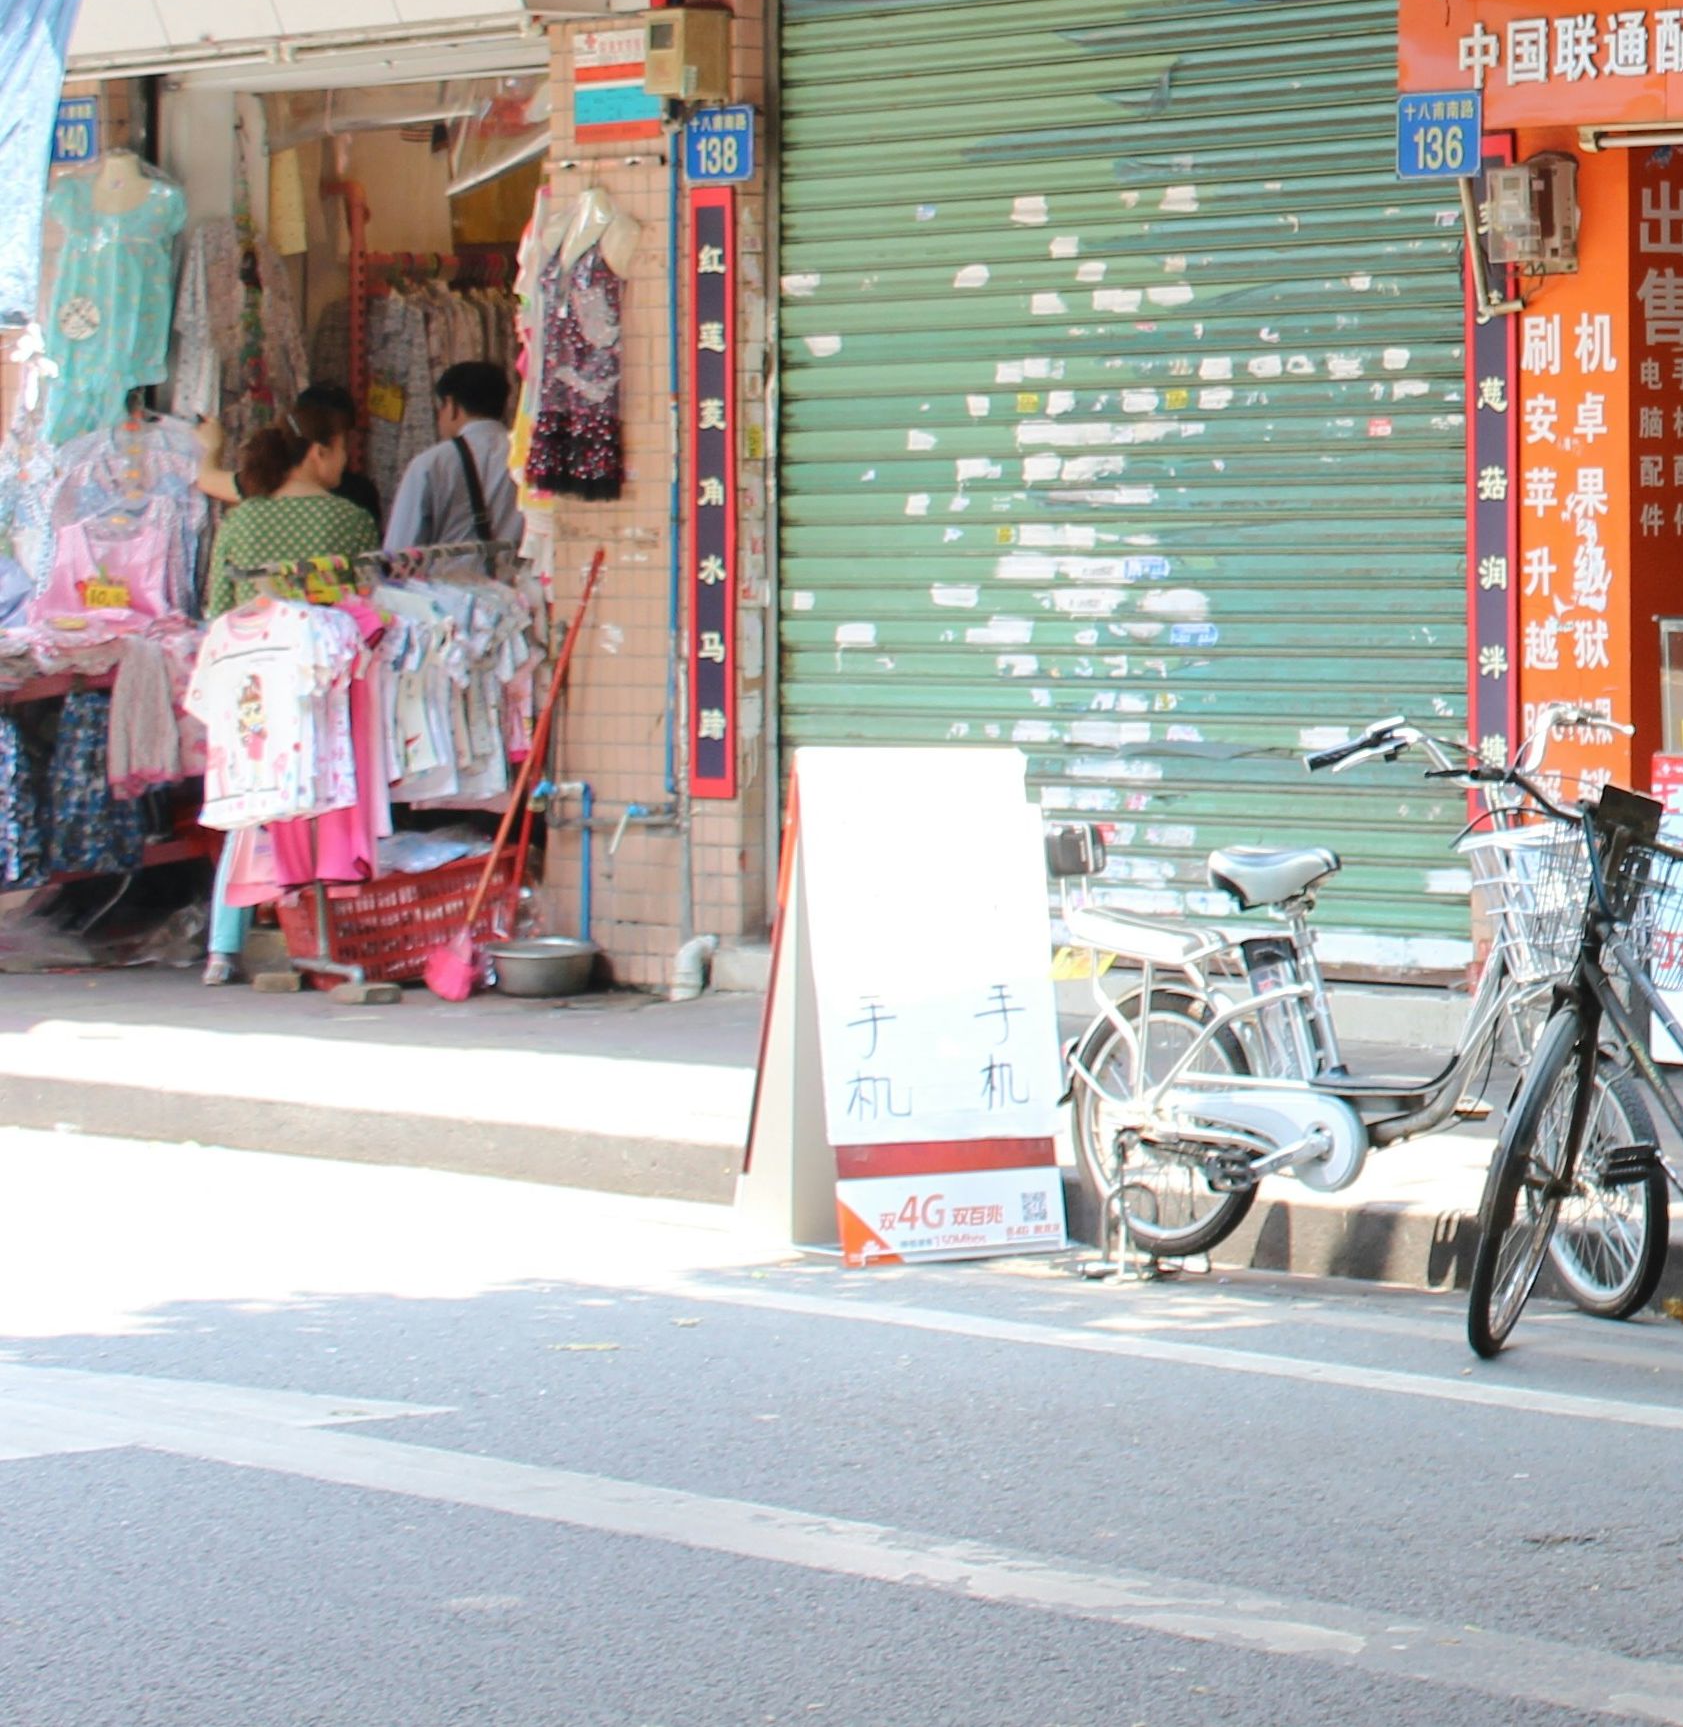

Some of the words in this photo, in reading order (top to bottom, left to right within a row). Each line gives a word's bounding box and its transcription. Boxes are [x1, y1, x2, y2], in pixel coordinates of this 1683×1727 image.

[1404, 99, 1475, 122] 十八甫南路
[56, 124, 89, 158] 140
[696, 135, 738, 175] 138
[1413, 126, 1464, 170] 136
[1519, 312, 1618, 377] 刷机
[1523, 392, 1608, 444] 安卓
[1639, 357, 1665, 537] 电脑配件
[1523, 467, 1608, 518] 苹果
[1523, 546, 1612, 612] 升级
[1523, 617, 1610, 672] 越狱
[847, 995, 912, 1123] 手机
[973, 984, 1030, 1111] 手机
